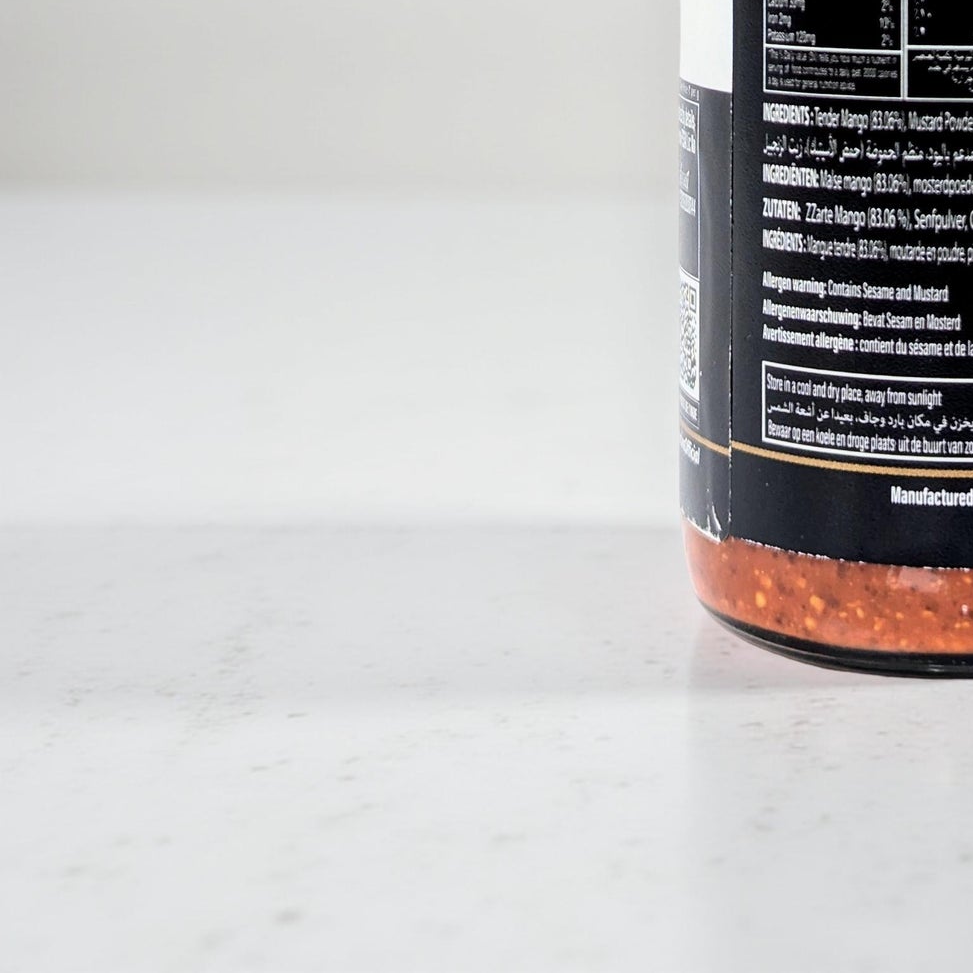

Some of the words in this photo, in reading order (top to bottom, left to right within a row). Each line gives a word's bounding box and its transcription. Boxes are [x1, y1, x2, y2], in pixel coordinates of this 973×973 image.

[841, 108, 868, 134] Mango
[908, 111, 943, 131] Mustard
[763, 197, 801, 221] ZUTATEN:
[834, 205, 866, 231] Mango
[914, 209, 968, 233] Senfpulver,
[762, 271, 792, 293] Allergen
[792, 277, 826, 299] warning:
[828, 279, 862, 298] Contains
[863, 282, 894, 299] Sesame
[896, 284, 912, 301] and
[914, 285, 948, 303] Mustard
[762, 299, 862, 330] Allergenenwaarschuwing:
[863, 311, 885, 327] Bevat
[886, 312, 913, 329] Sesam
[914, 317, 925, 329] en
[926, 313, 962, 331] Mosterd
[762, 324, 814, 347] Avertissement
[860, 337, 894, 354] contient
[896, 337, 908, 355] du
[908, 339, 942, 356] sésame
[944, 341, 954, 356] et
[955, 340, 966, 356] de
[767, 373, 782, 391] Store
[784, 375, 790, 392] in
[792, 381, 796, 393] a
[797, 379, 812, 395] cool
[812, 381, 826, 398] and
[828, 381, 840, 403] dry
[841, 383, 863, 403] place,
[864, 390, 886, 407] away
[887, 387, 906, 405] from
[908, 389, 942, 409] sunlight
[816, 409, 830, 421] عن
[888, 413, 904, 429] بارد
[907, 413, 931, 429] مكان
[933, 415, 948, 434] في
[768, 419, 791, 438] Bewaar
[792, 427, 800, 443] op
[802, 429, 814, 443] een
[816, 427, 835, 445] koele
[836, 433, 846, 447] en
[846, 431, 869, 452] droge
[898, 435, 910, 452] uit
[911, 435, 921, 453] de
[922, 435, 946, 453] buurt
[948, 441, 963, 454] van
[891, 485, 973, 507] Manufactured
